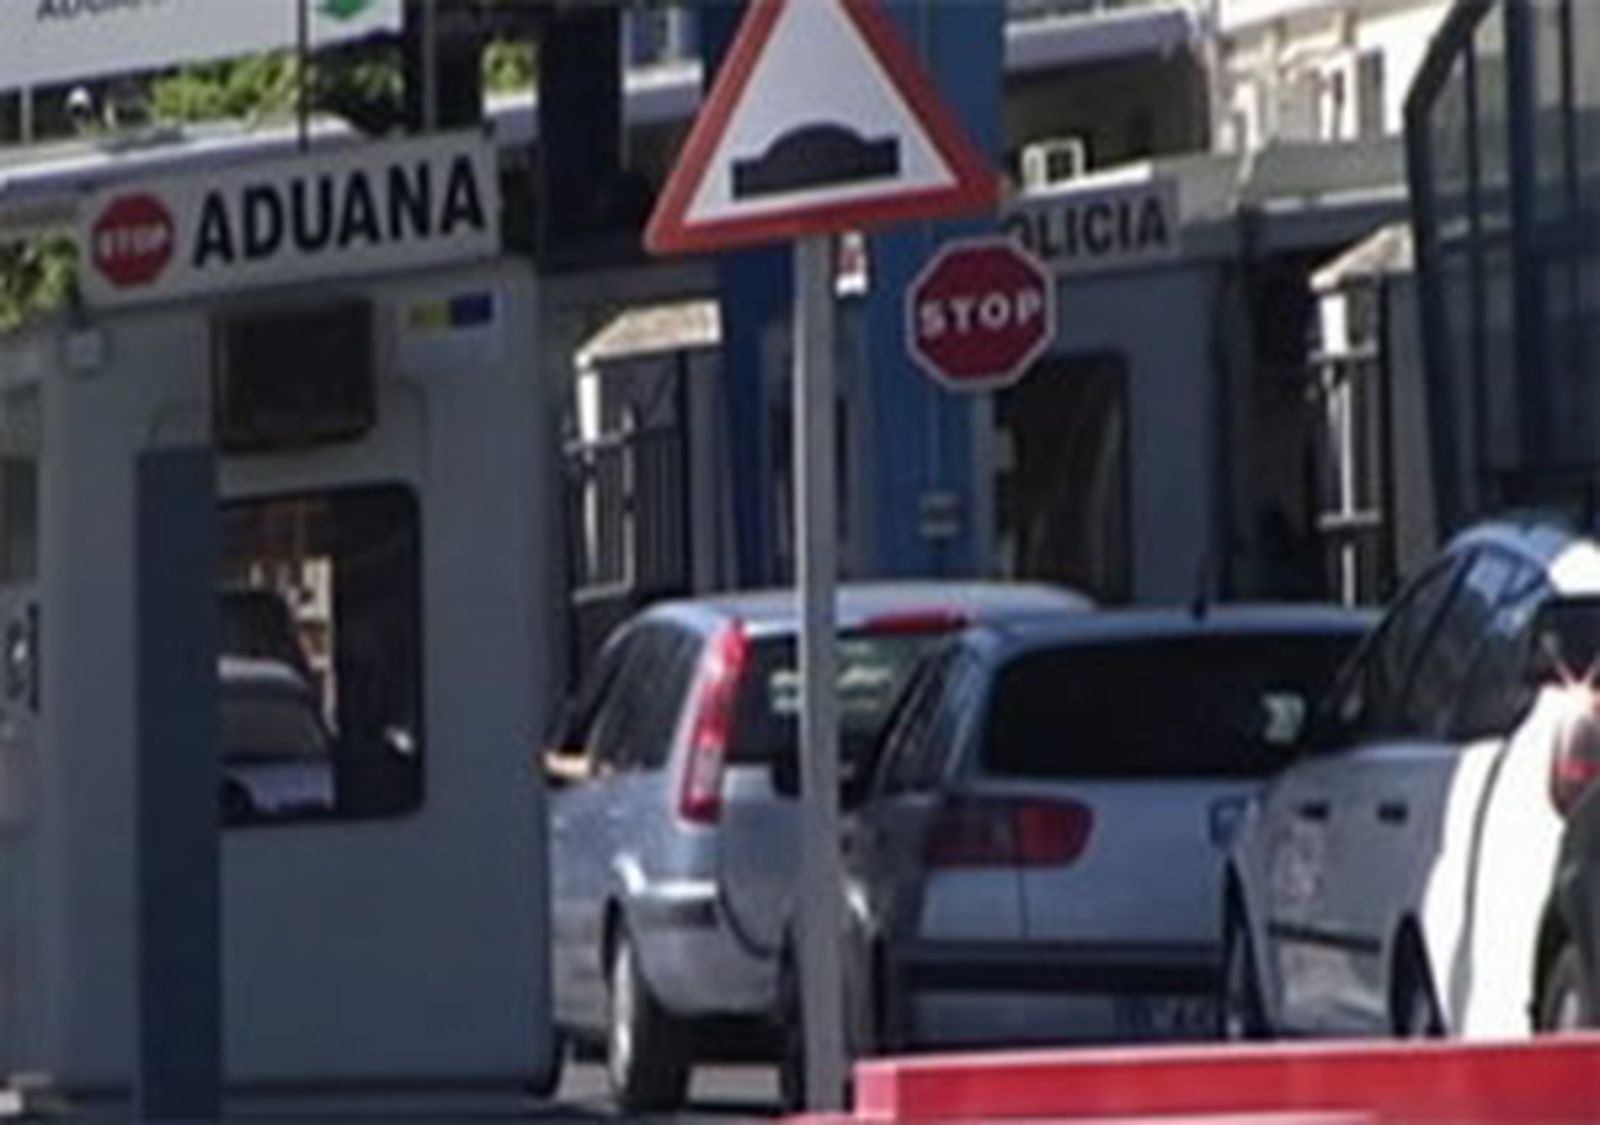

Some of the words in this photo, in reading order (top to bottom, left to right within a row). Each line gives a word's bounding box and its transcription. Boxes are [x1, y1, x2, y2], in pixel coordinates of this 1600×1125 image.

[191, 155, 485, 268] ADUANA
[1003, 196, 1169, 258] OLICIA
[920, 288, 1043, 338] STOP
